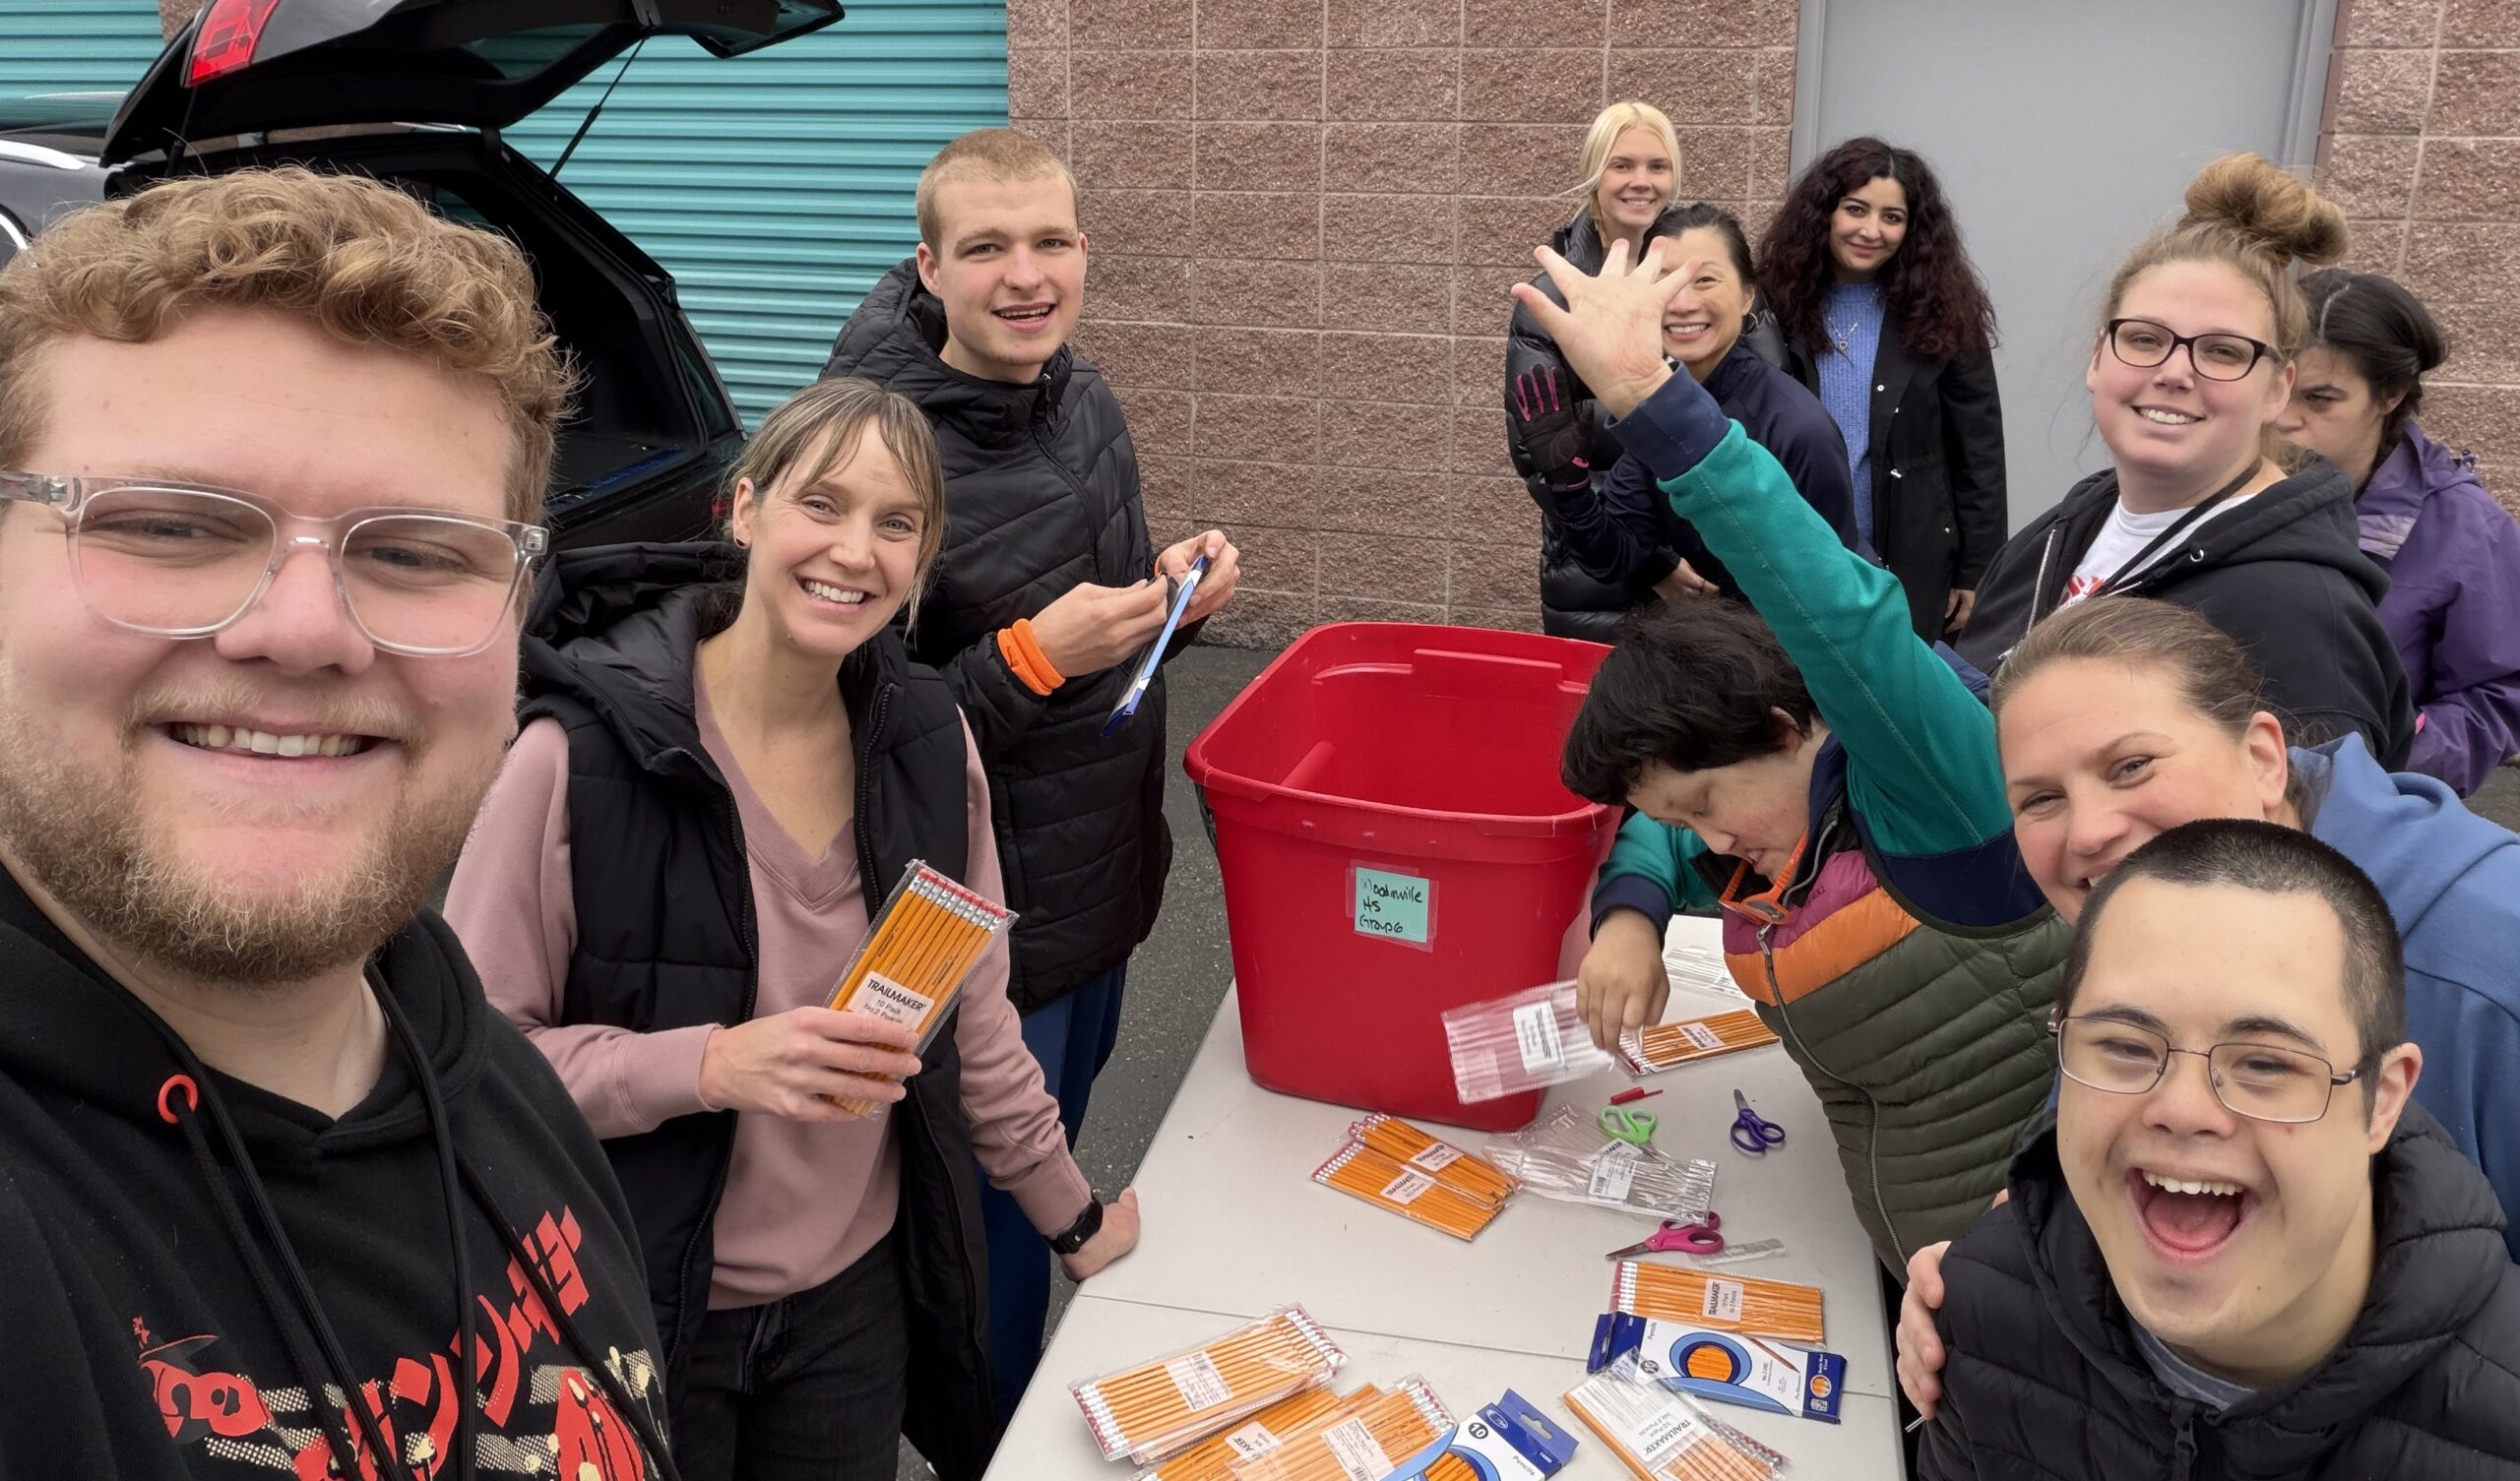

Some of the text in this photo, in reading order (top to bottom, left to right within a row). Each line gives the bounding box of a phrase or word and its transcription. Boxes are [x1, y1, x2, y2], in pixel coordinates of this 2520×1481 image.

[1362, 896, 1382, 913] HS
[867, 978, 923, 1012] TRAILMAKER
[876, 999, 903, 1016] 10 Pack
[1708, 1281, 1720, 1316] TRAILMAKER
[1644, 1419, 1691, 1453] TRAILMAKER
[1512, 1454, 1536, 1476] Pencils
